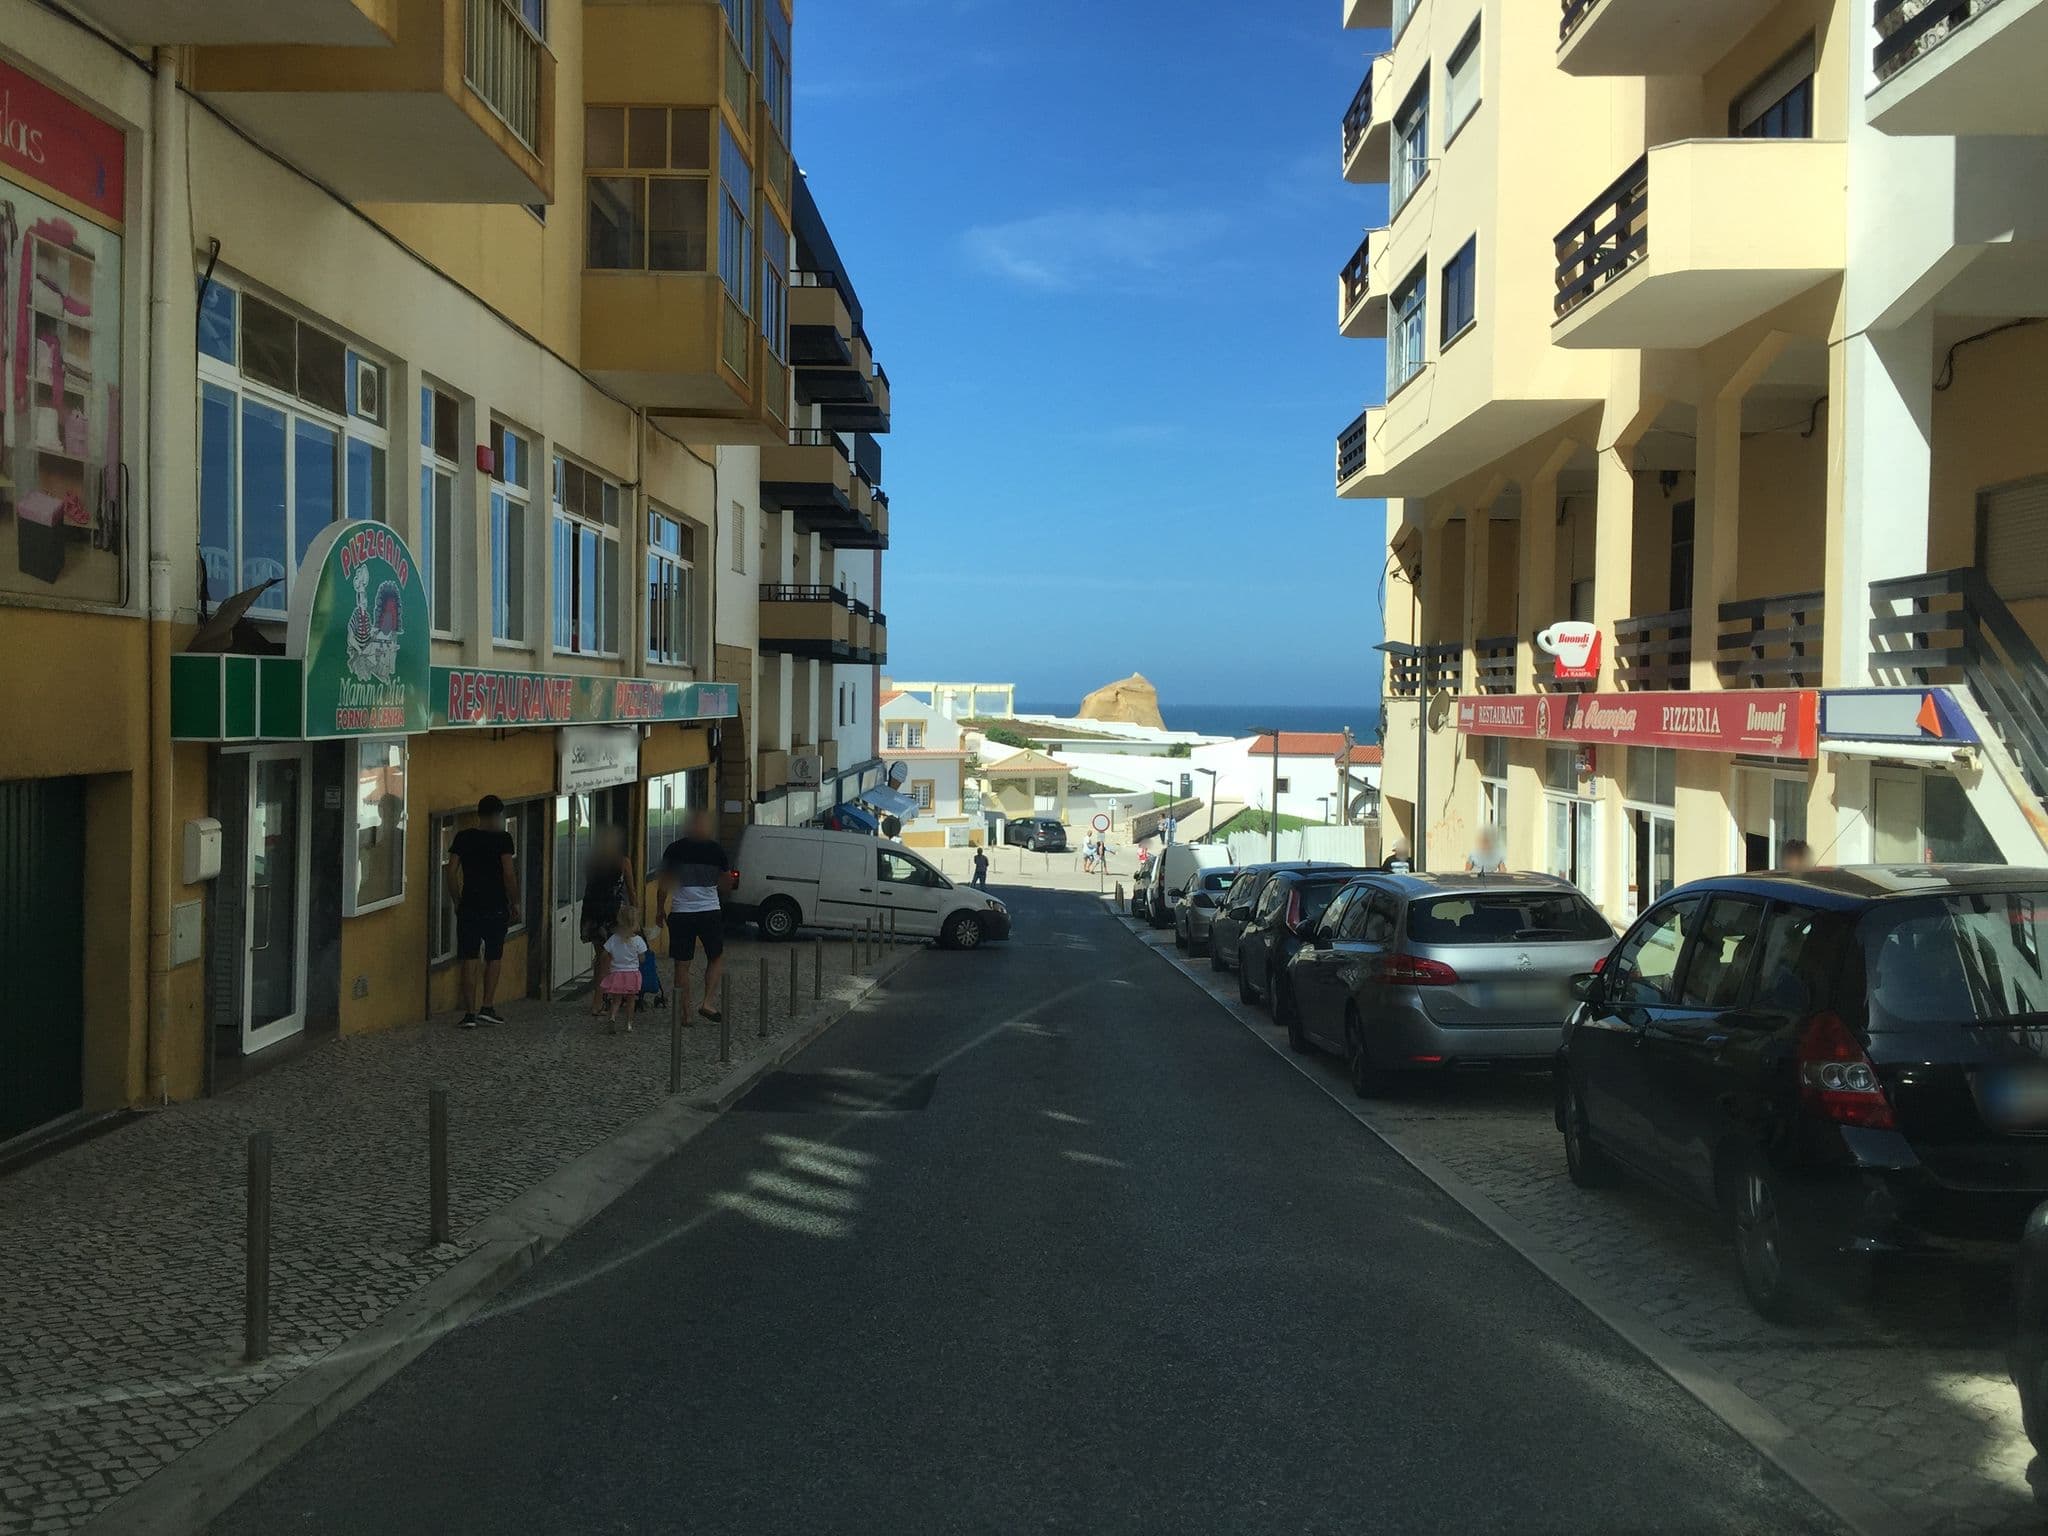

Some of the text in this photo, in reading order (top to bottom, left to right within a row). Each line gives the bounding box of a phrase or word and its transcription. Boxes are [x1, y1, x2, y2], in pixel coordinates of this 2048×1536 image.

[341, 528, 409, 590] PIZZERIA
[338, 676, 405, 706] Mamma Mia
[448, 672, 573, 722] RESTAURANTE
[336, 708, 369, 730] FORNO
[1478, 706, 1525, 725] RESTAURANTE
[1662, 706, 1721, 733] PIZZERIA
[1746, 702, 1787, 732] Buondi
